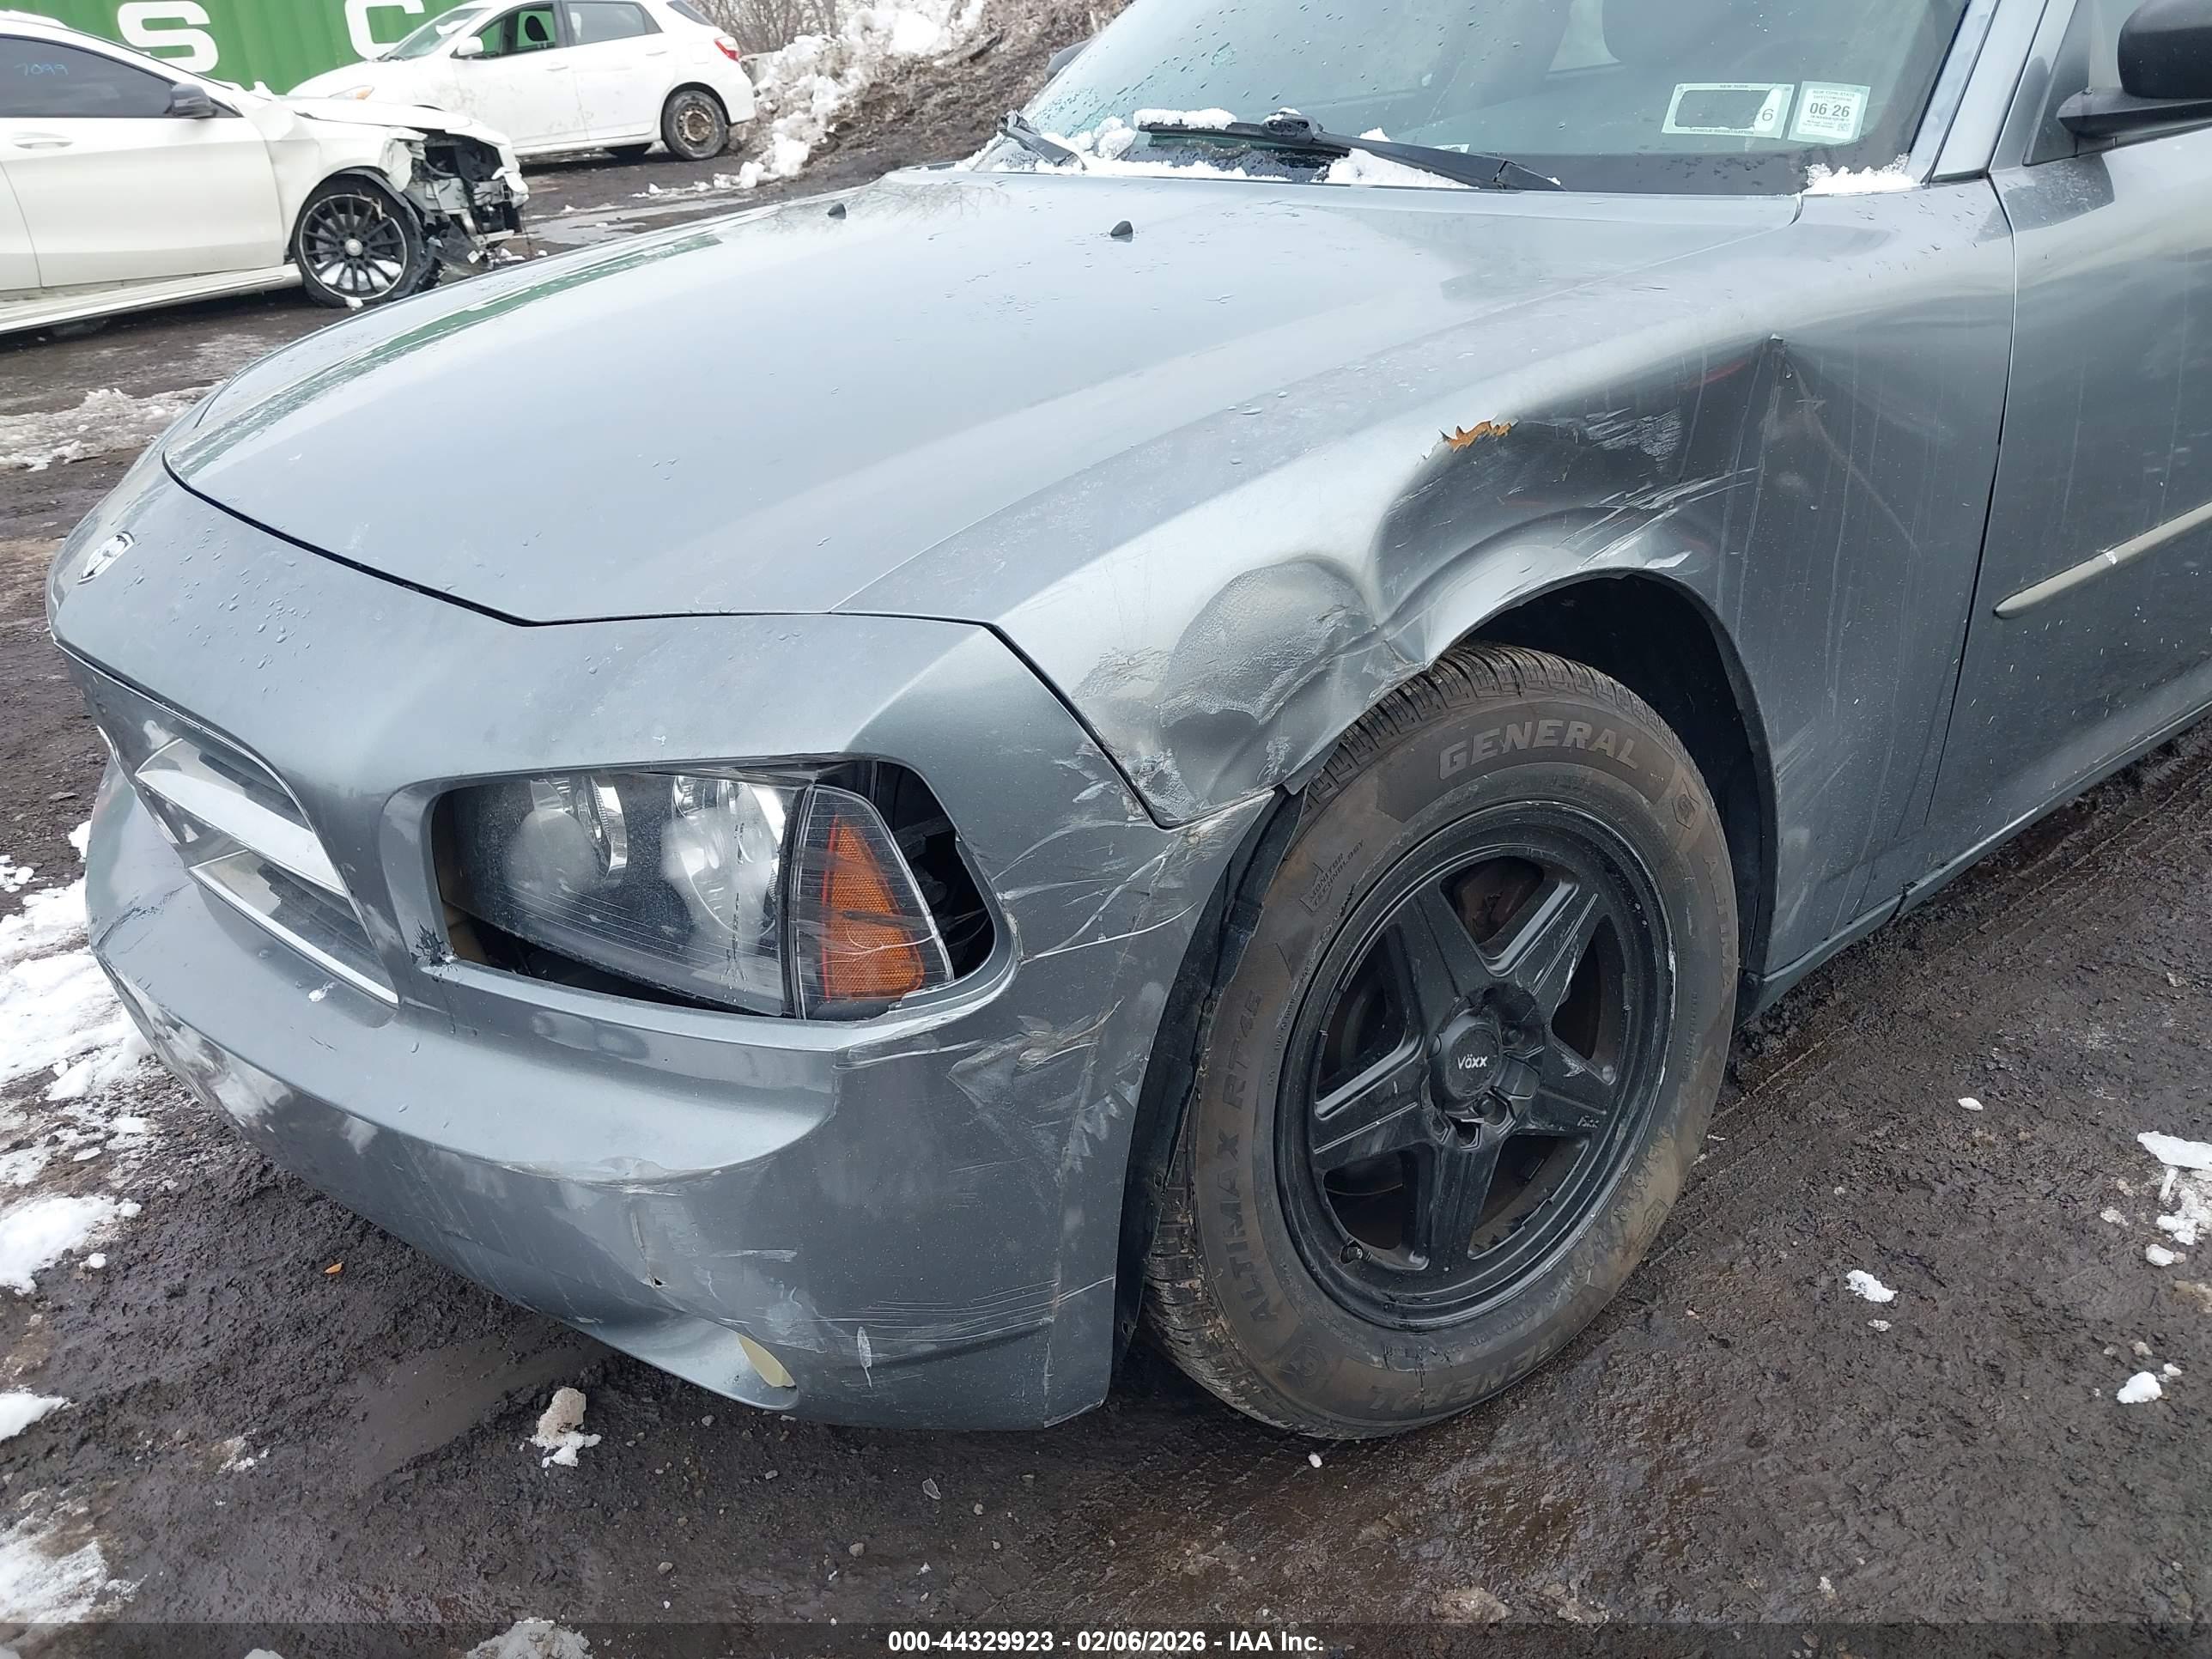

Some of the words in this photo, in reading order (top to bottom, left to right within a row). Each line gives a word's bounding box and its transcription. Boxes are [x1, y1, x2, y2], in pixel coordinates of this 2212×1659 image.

[1761, 108, 1774, 122] 6
[1809, 102, 1828, 115] 06
[1832, 104, 1850, 118] 26
[1439, 720, 1639, 781] GENERAL
[1217, 1126, 1279, 1322] ALTIMAX
